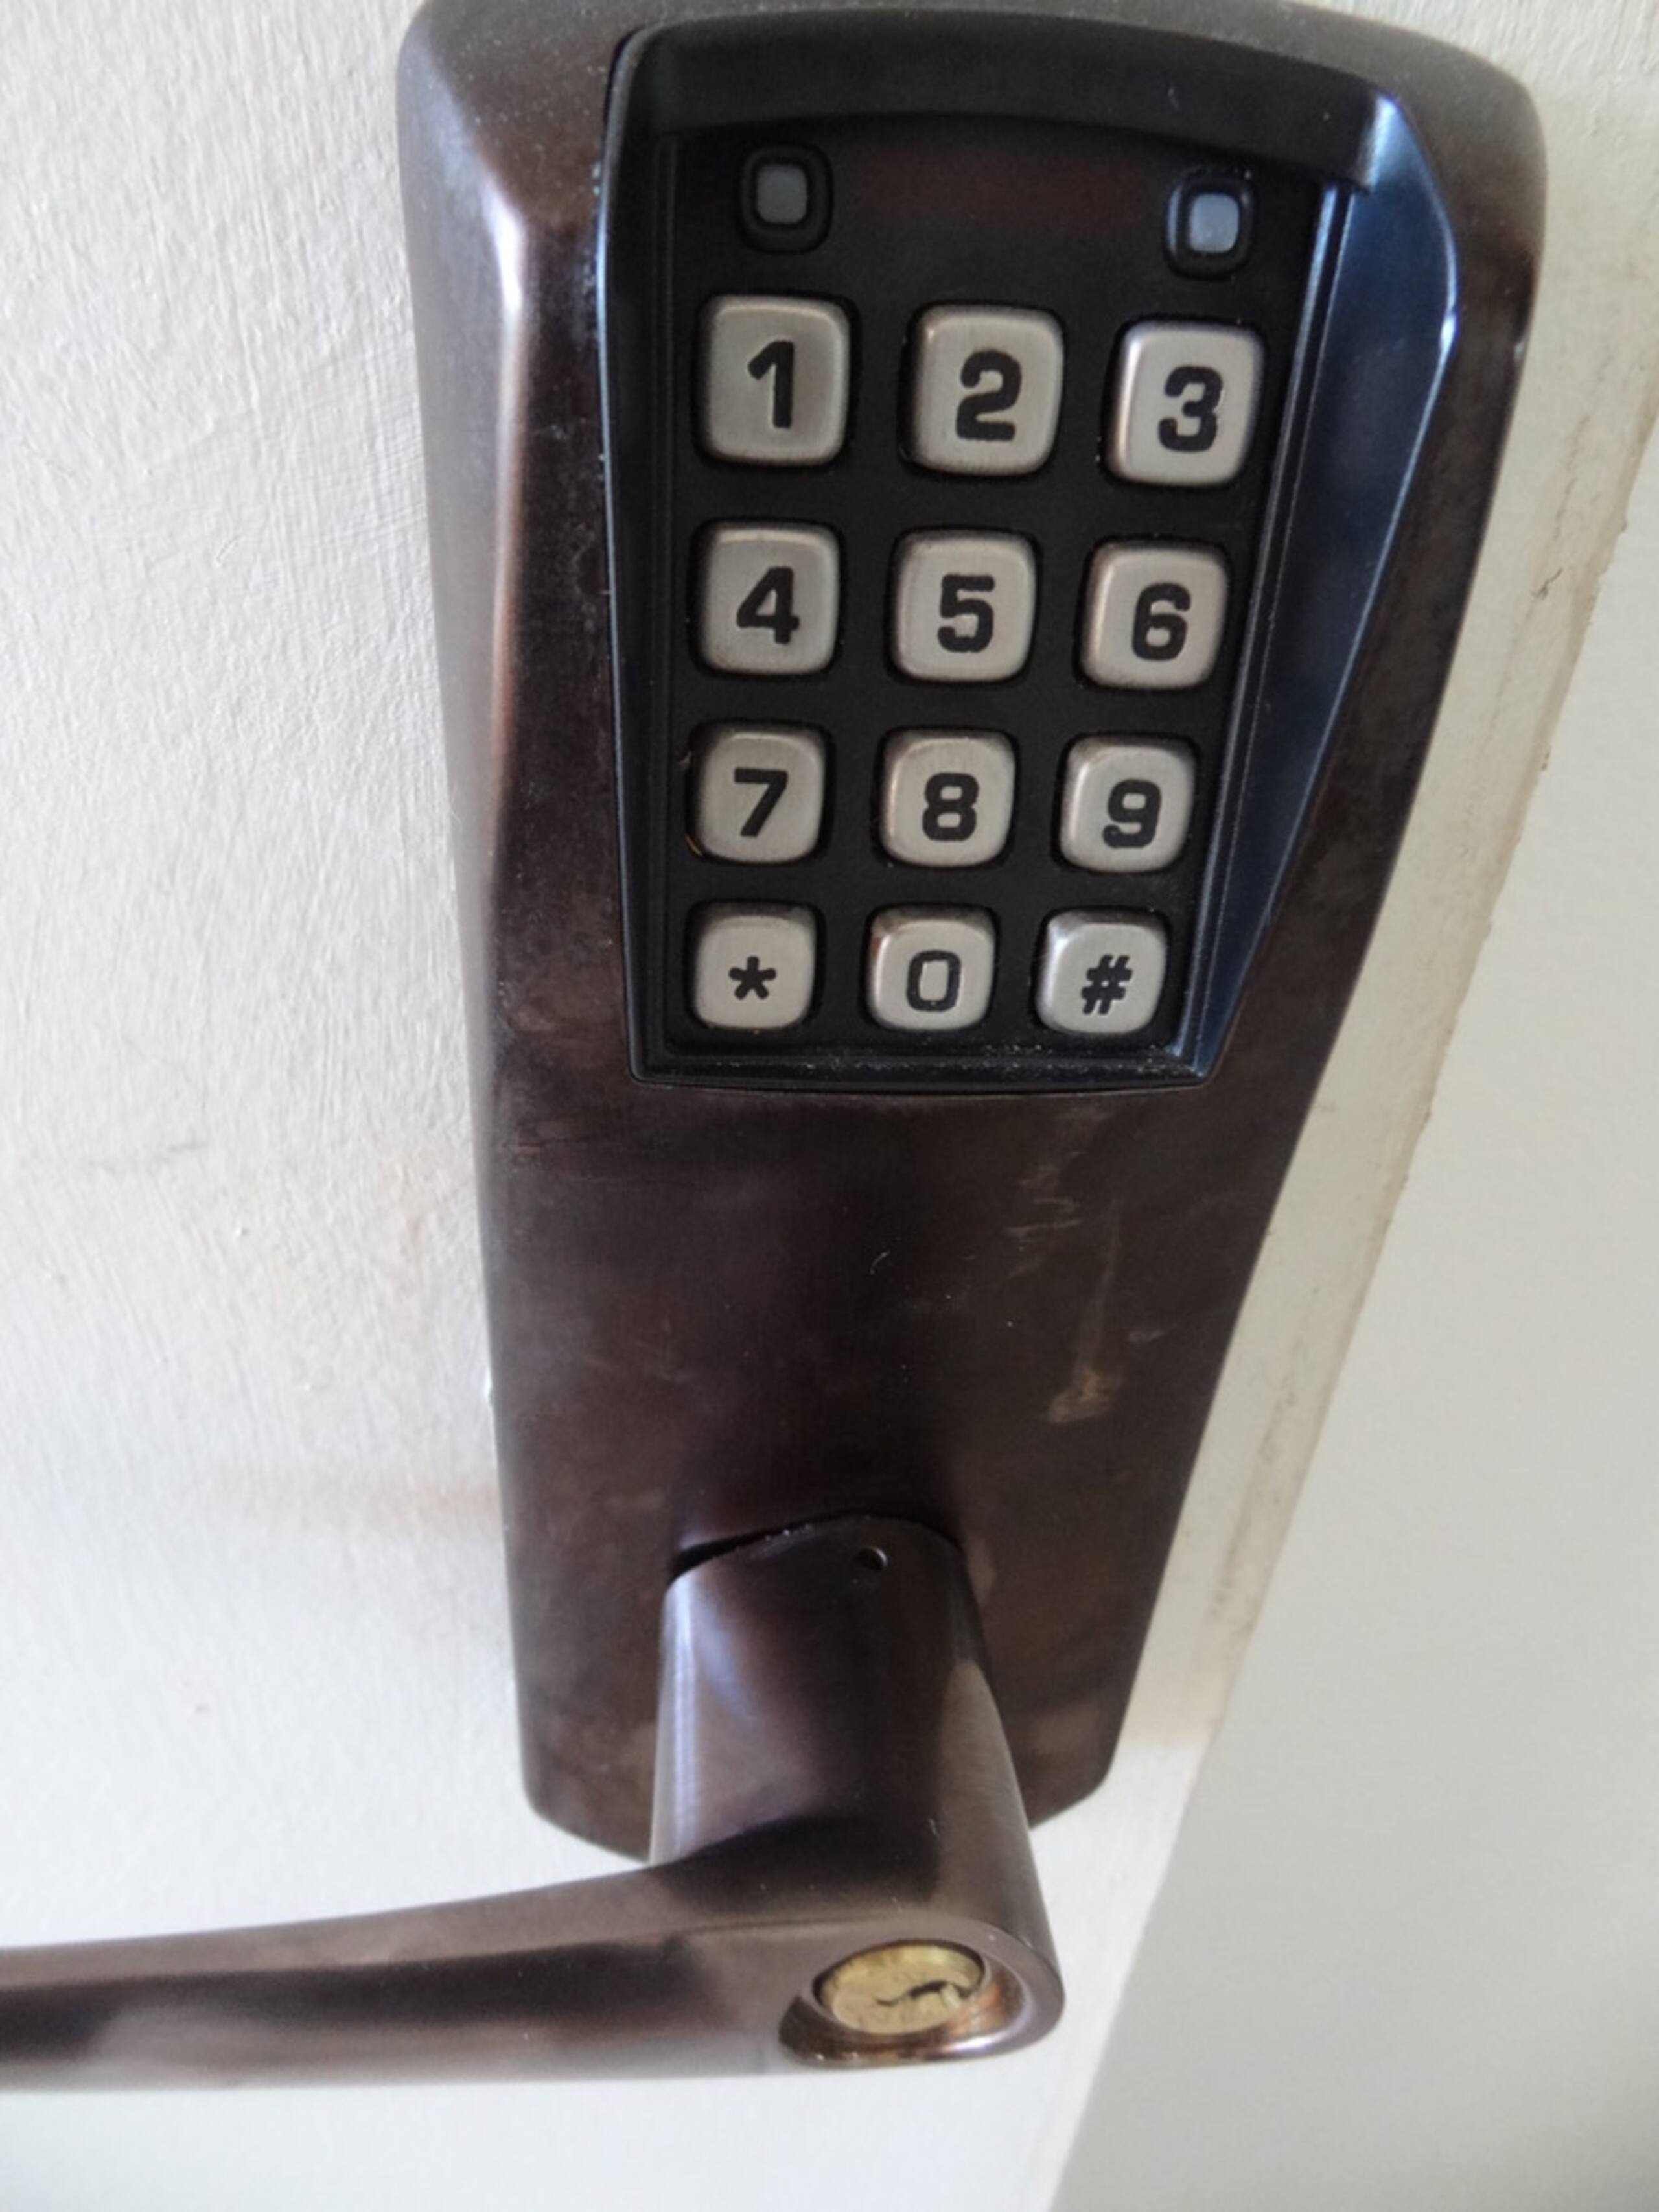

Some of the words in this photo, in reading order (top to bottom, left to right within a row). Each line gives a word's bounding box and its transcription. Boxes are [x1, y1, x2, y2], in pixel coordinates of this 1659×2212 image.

[748, 341, 795, 428] 1
[956, 349, 1022, 441] 2
[1159, 366, 1223, 452] 3
[737, 567, 800, 645] 4
[938, 574, 995, 653] 5
[1132, 583, 1190, 661] 6
[734, 767, 788, 837] 7
[922, 773, 979, 841] 8
[1102, 779, 1161, 848] 9
